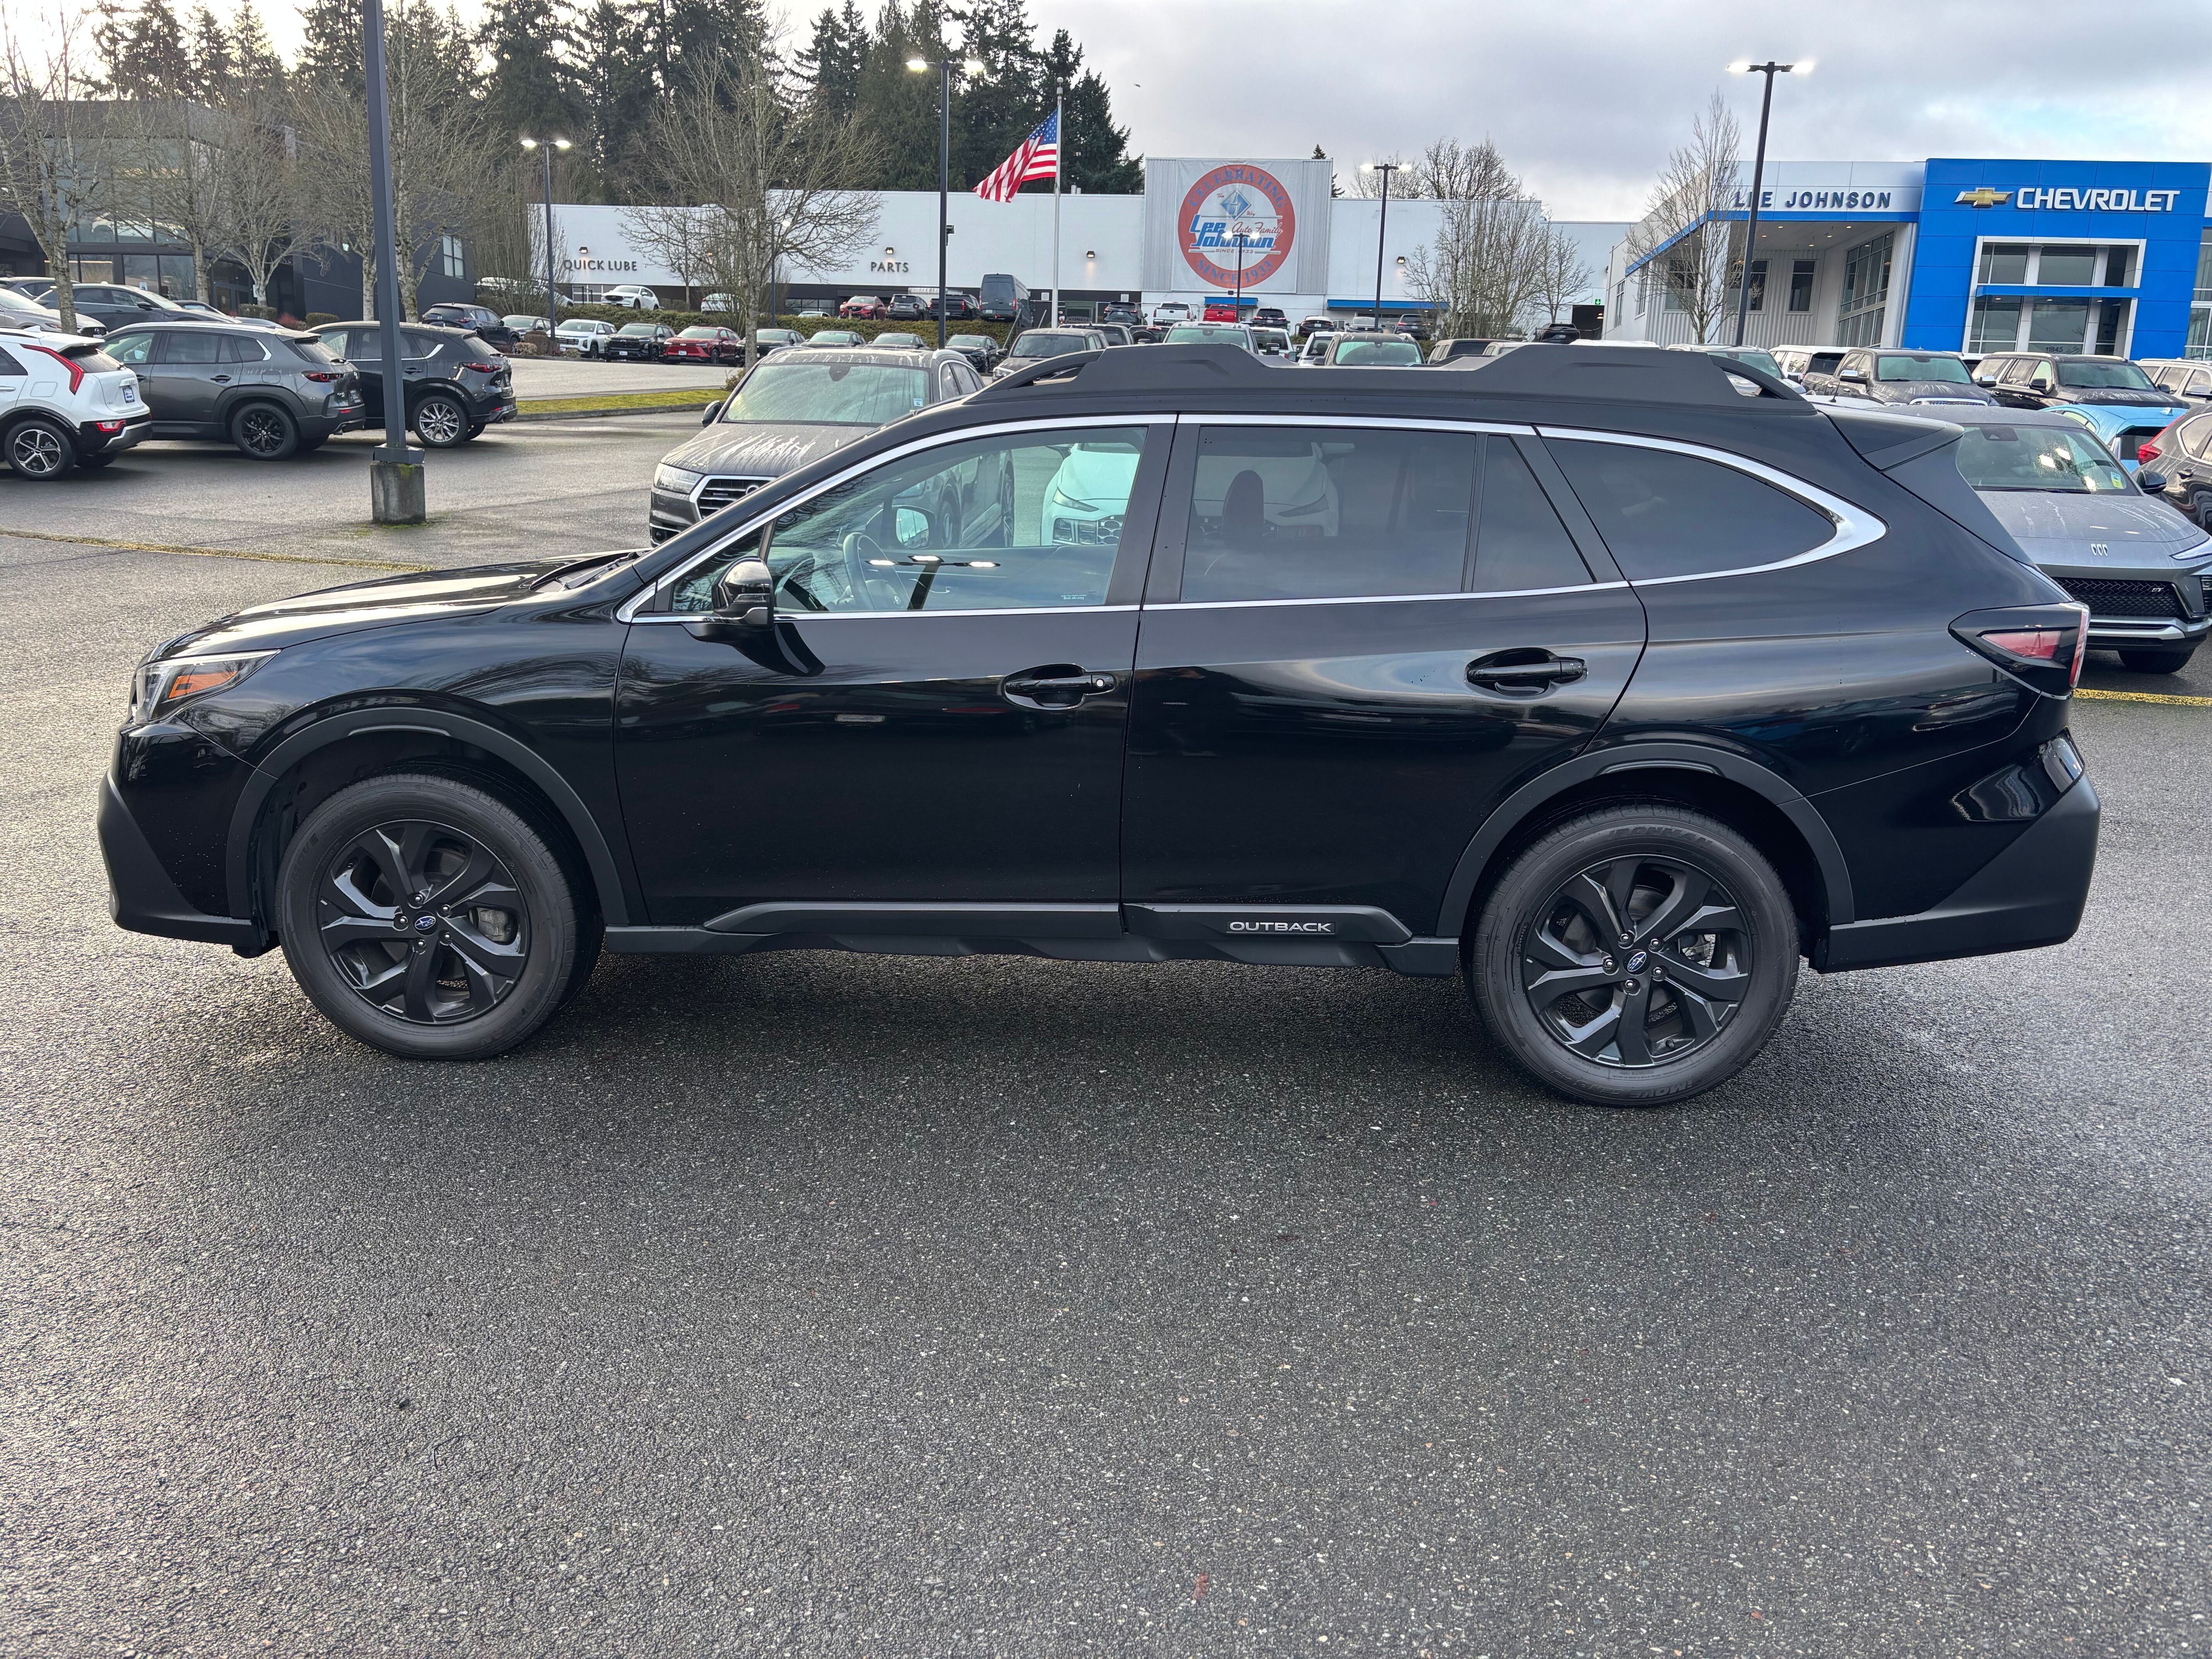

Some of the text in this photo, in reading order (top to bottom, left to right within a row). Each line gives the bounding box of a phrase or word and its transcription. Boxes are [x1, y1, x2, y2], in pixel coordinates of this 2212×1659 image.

[1188, 168, 1287, 208] CELEBRATING
[1786, 191, 1891, 208] JOHNSON
[2017, 187, 2180, 211] CHEVROLET
[1190, 215, 1226, 233] Lee
[1231, 222, 1283, 239] Auto Family
[563, 259, 638, 271] QUICK LUBE
[871, 261, 909, 273] PARTS
[1195, 259, 1273, 284] SINCE 1933
[1608, 826, 1713, 847] IRONMAN
[1229, 921, 1332, 932] OUTBACK
